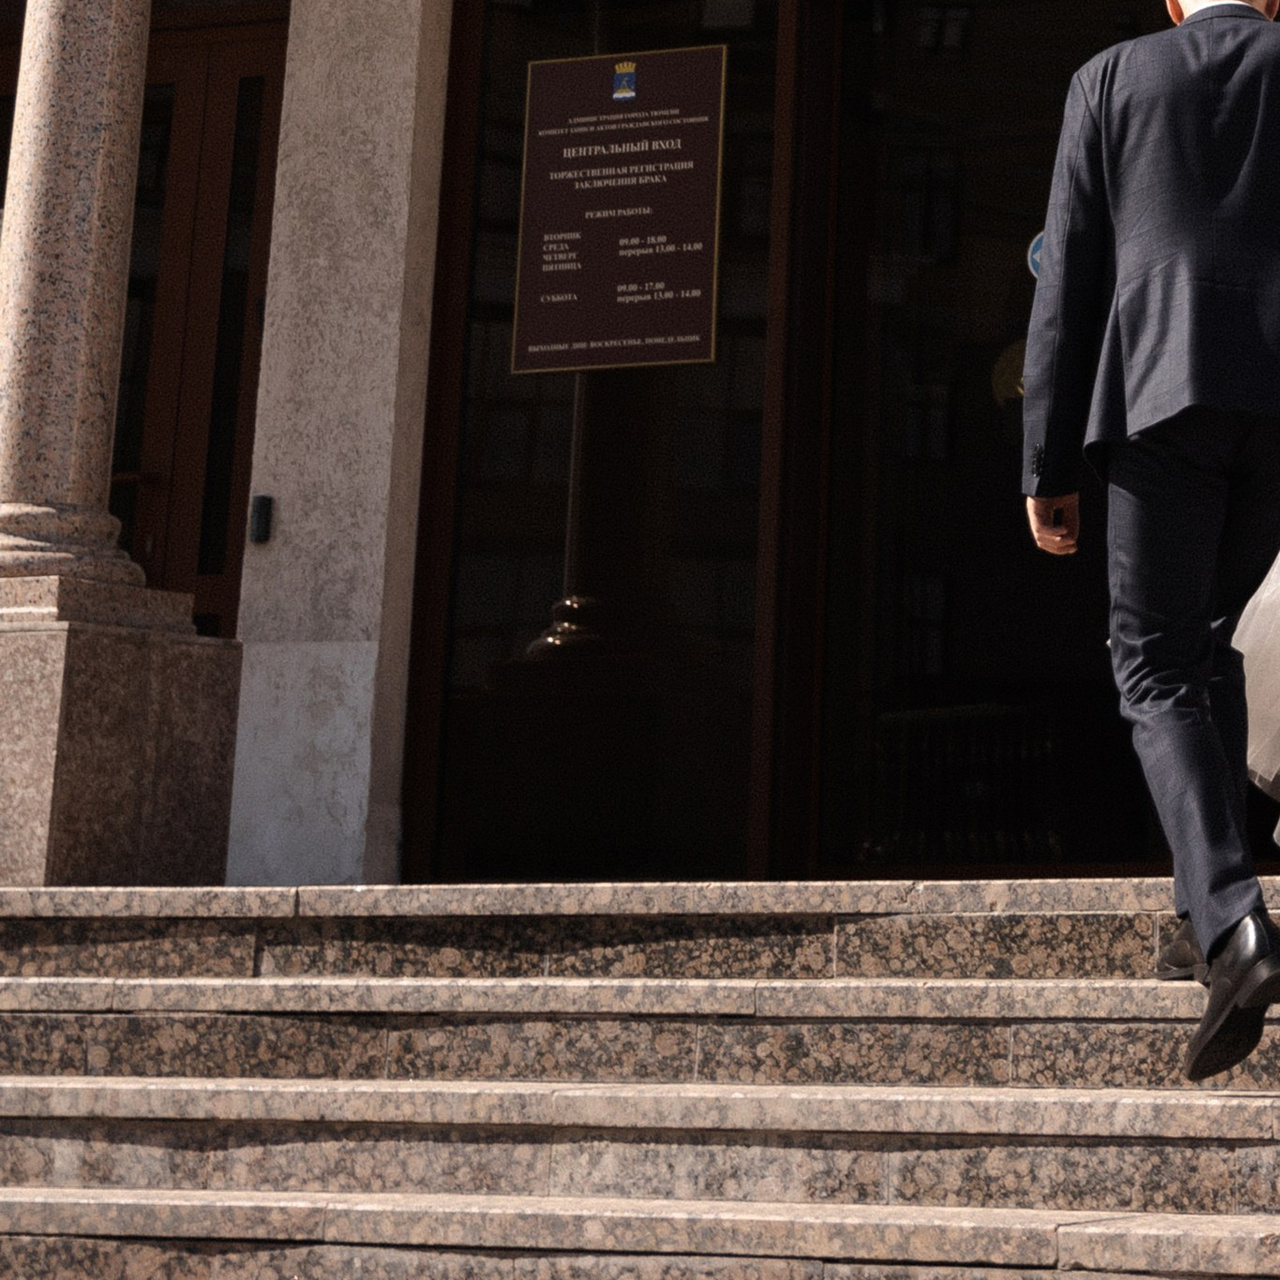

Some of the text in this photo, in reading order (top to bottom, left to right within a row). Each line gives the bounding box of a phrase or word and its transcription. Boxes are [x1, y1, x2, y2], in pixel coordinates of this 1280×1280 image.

[563, 138, 682, 159] ЦЕНТРАЛЬНЫЙ ВХОД
[549, 160, 694, 181] ТОРЖЕСТВЕННАЯ РЕГИСТРАЦИЯ
[574, 174, 667, 189] ЗАКЛЮЧЕНИЯ БРАКА
[585, 209, 616, 219] РЕЖИМ
[544, 232, 582, 242] ВТОРНИК
[543, 243, 570, 251] СРЕДА
[619, 246, 653, 257] перерыв
[543, 252, 577, 261] ЧЕТВЕРГ
[542, 262, 582, 272] ПЯТНИЦА
[540, 293, 578, 303] СУББОТА
